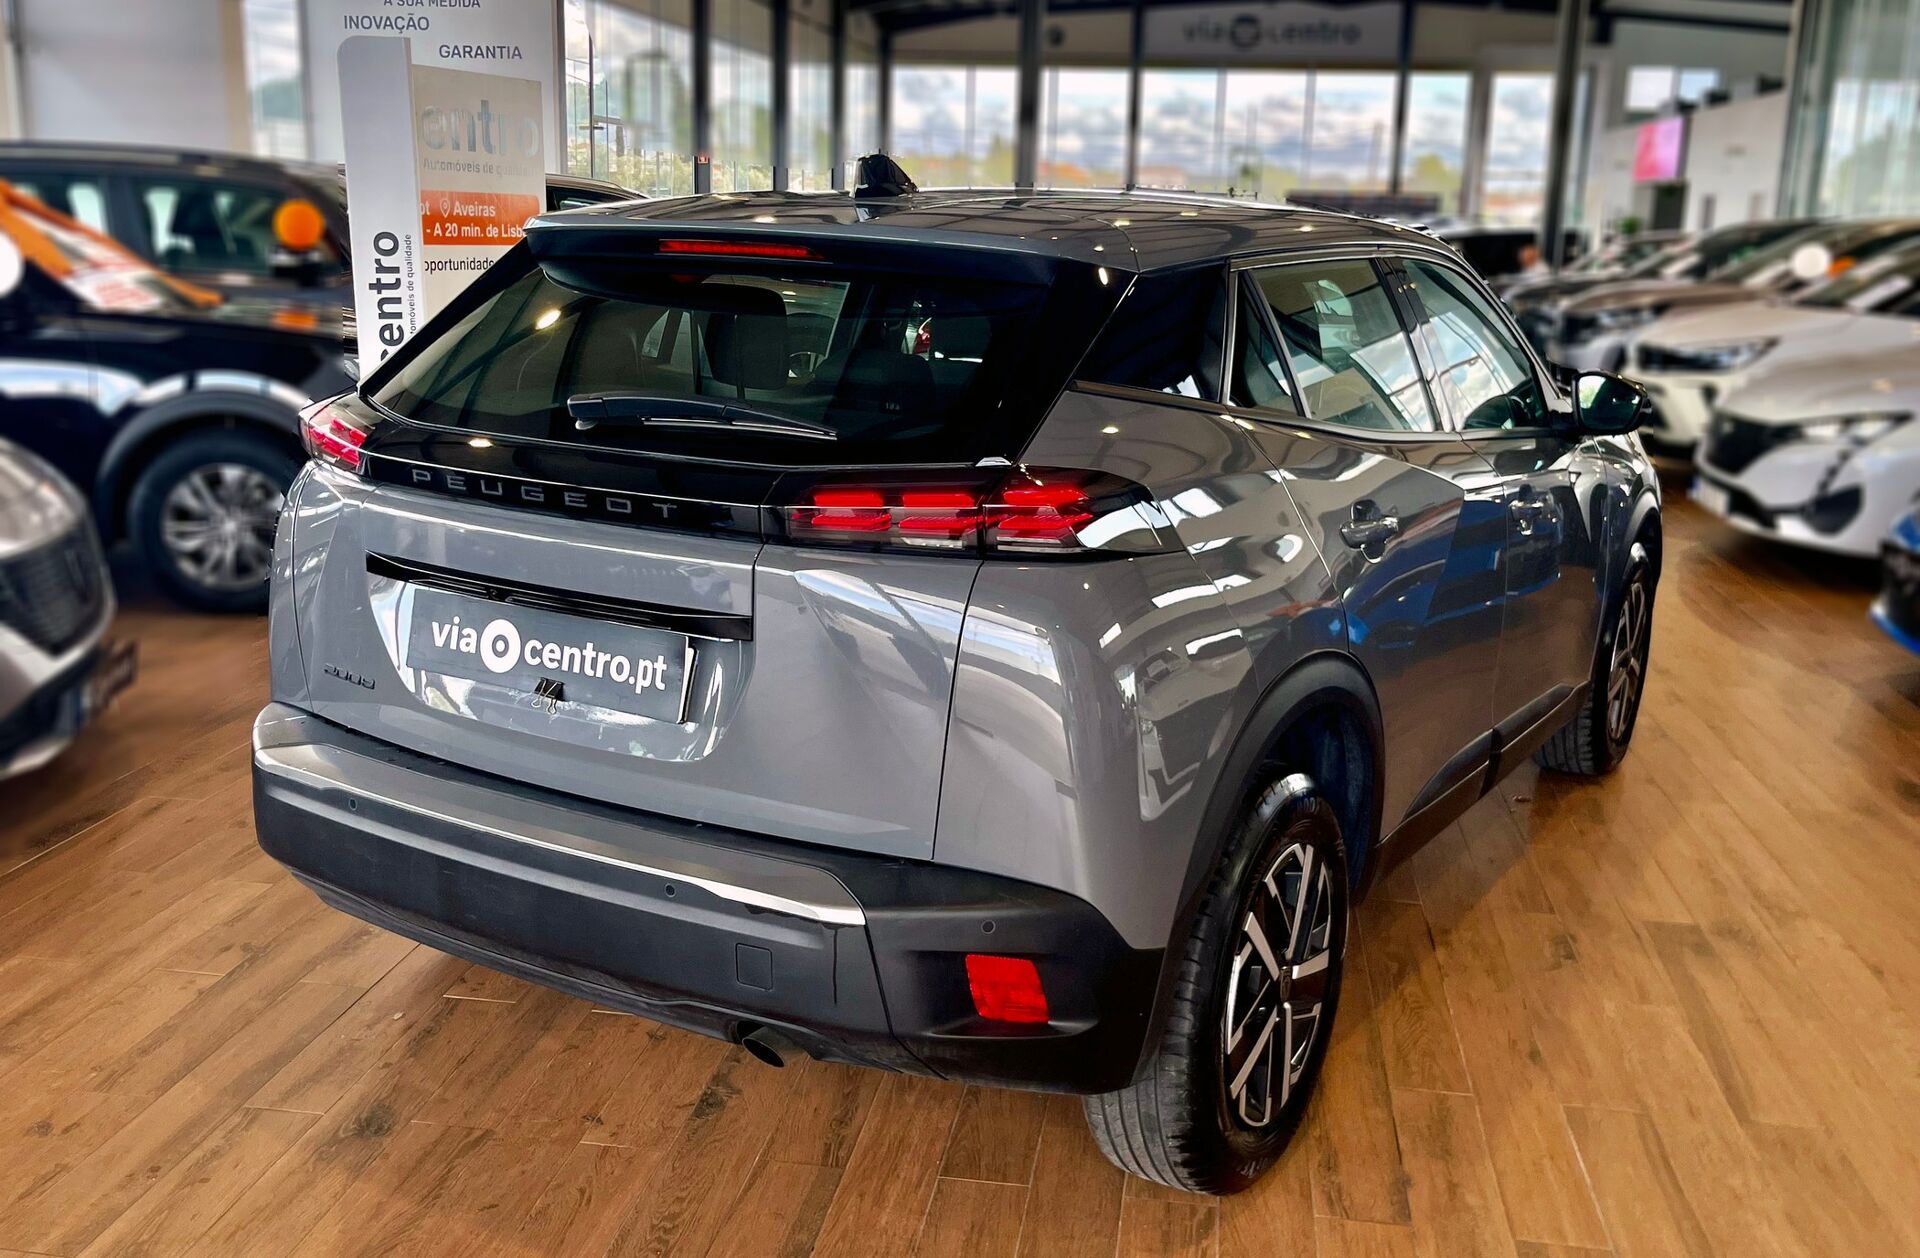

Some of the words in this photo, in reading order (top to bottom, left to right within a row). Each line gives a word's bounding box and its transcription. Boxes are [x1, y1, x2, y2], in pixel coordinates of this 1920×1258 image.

[343, 13, 430, 34] INOVAÇÃO
[438, 44, 523, 60] GARANTIA
[453, 201, 496, 217] Aveiras
[433, 223, 443, 237] A
[444, 223, 459, 237] 20
[461, 223, 484, 238] min.
[486, 224, 499, 238] de
[404, 234, 415, 279] qualidade
[368, 231, 405, 361] entro
[405, 280, 415, 292] de
[406, 294, 416, 335] omóveis
[412, 468, 678, 519] PEUGEOT
[431, 616, 478, 654] via
[524, 638, 668, 695] centro.pt
